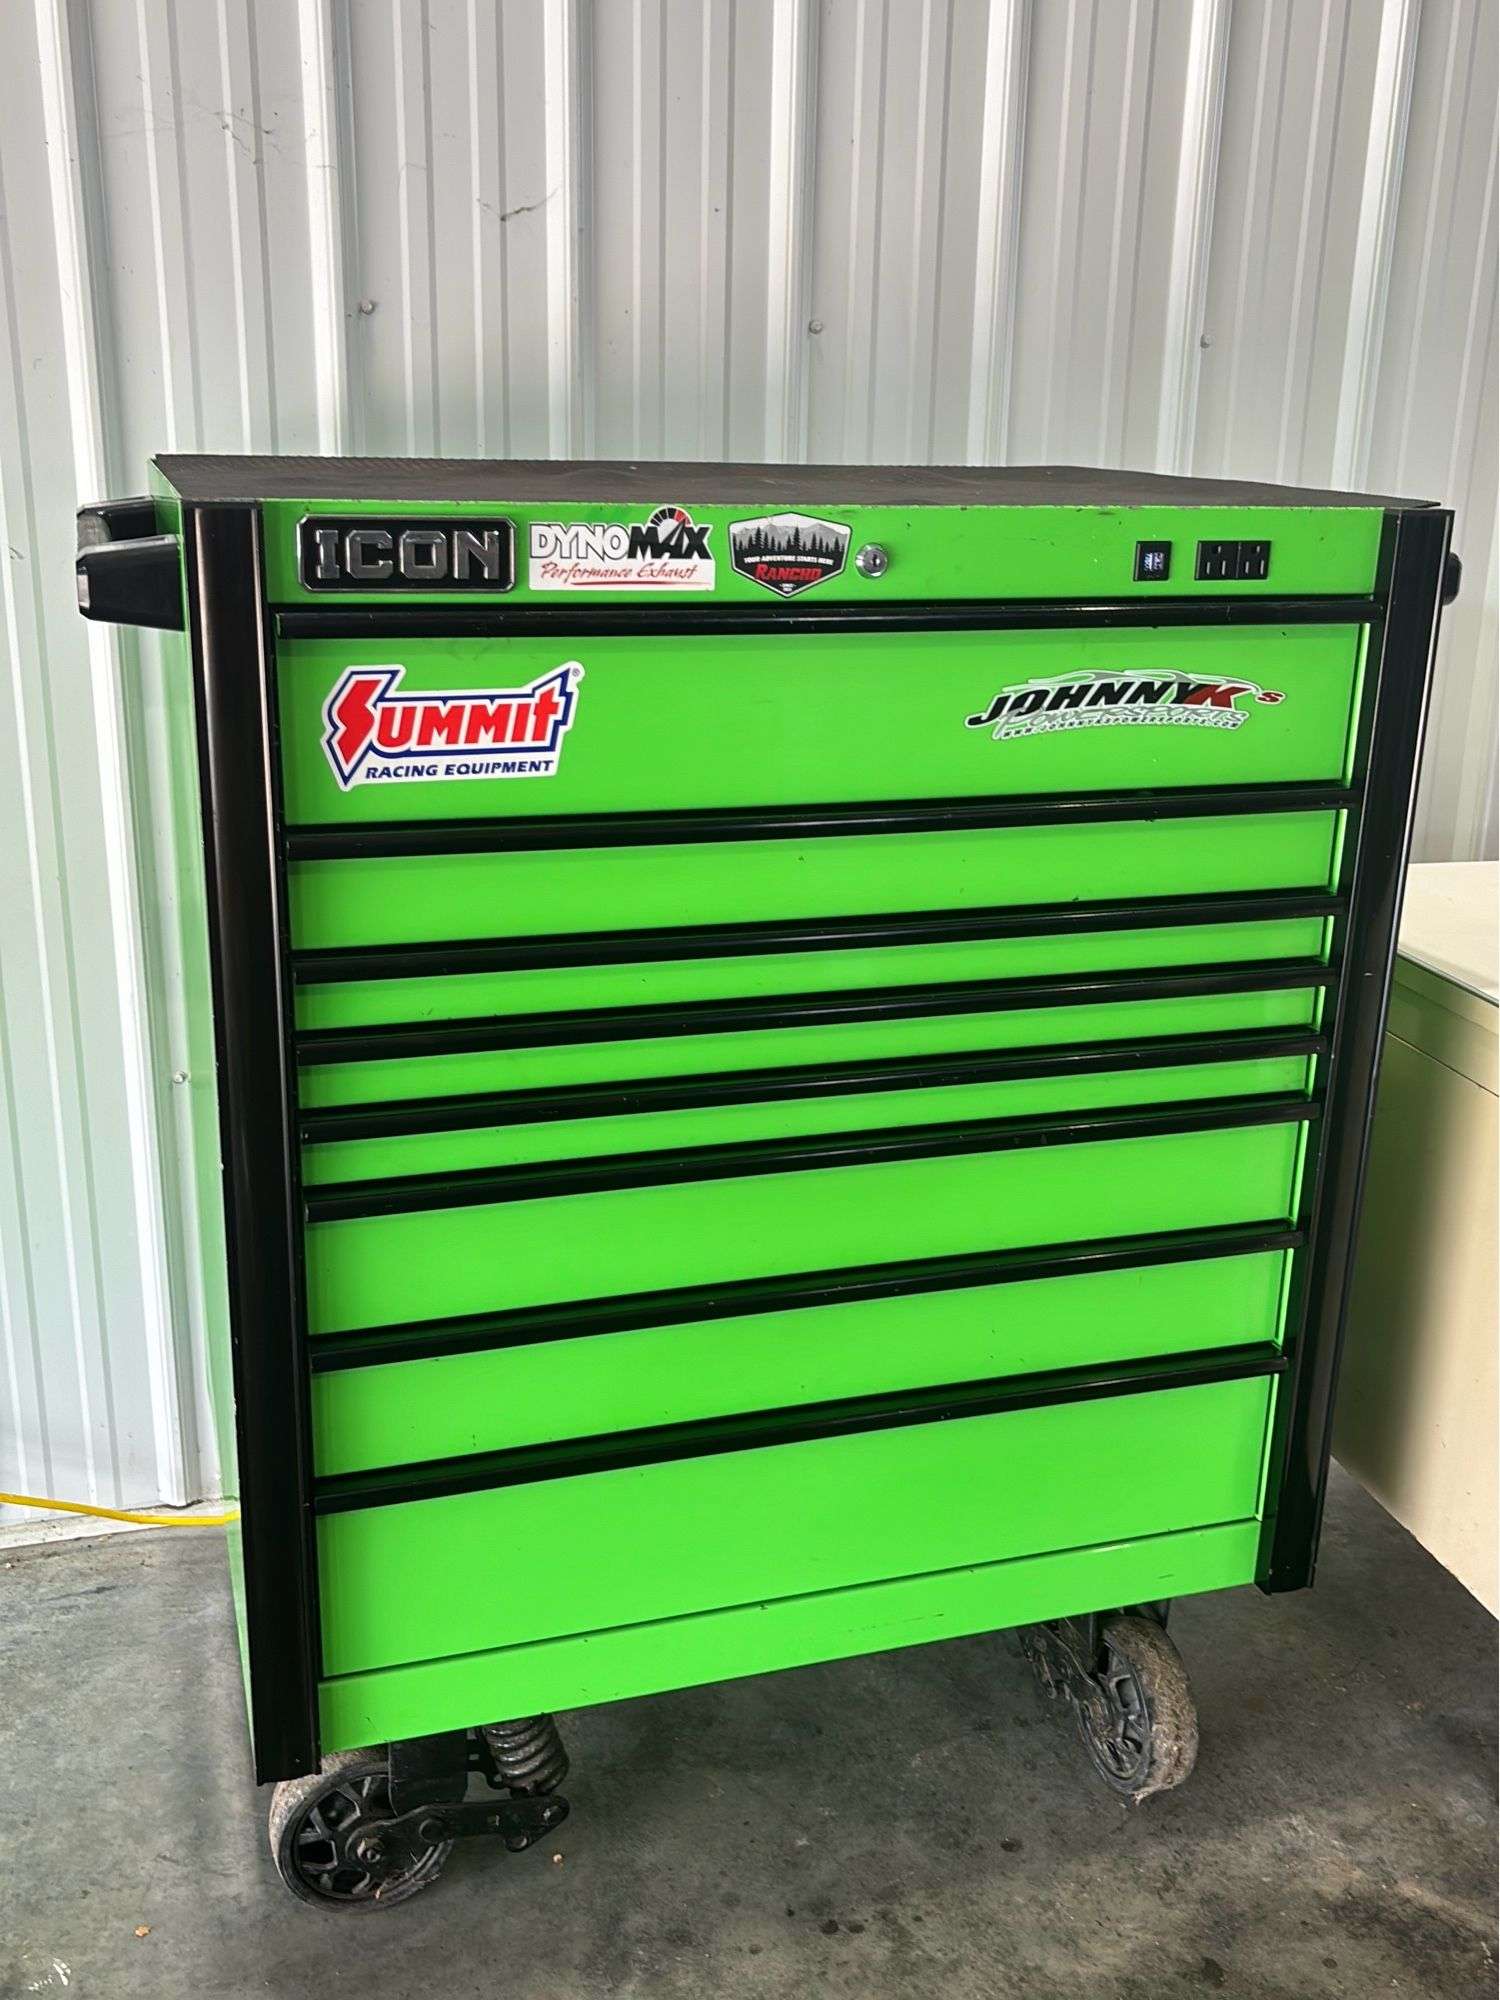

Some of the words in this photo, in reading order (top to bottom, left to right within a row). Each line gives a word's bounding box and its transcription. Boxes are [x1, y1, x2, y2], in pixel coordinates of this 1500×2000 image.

[316, 529, 499, 579] ICON
[530, 518, 713, 560] DYNOMAX
[541, 561, 633, 583] Performance
[637, 560, 698, 578] Exhaust
[755, 564, 822, 580] RANCHO
[337, 680, 560, 765] SUMMIT
[365, 764, 438, 780] RACING
[444, 760, 554, 776] EQUIPMENT
